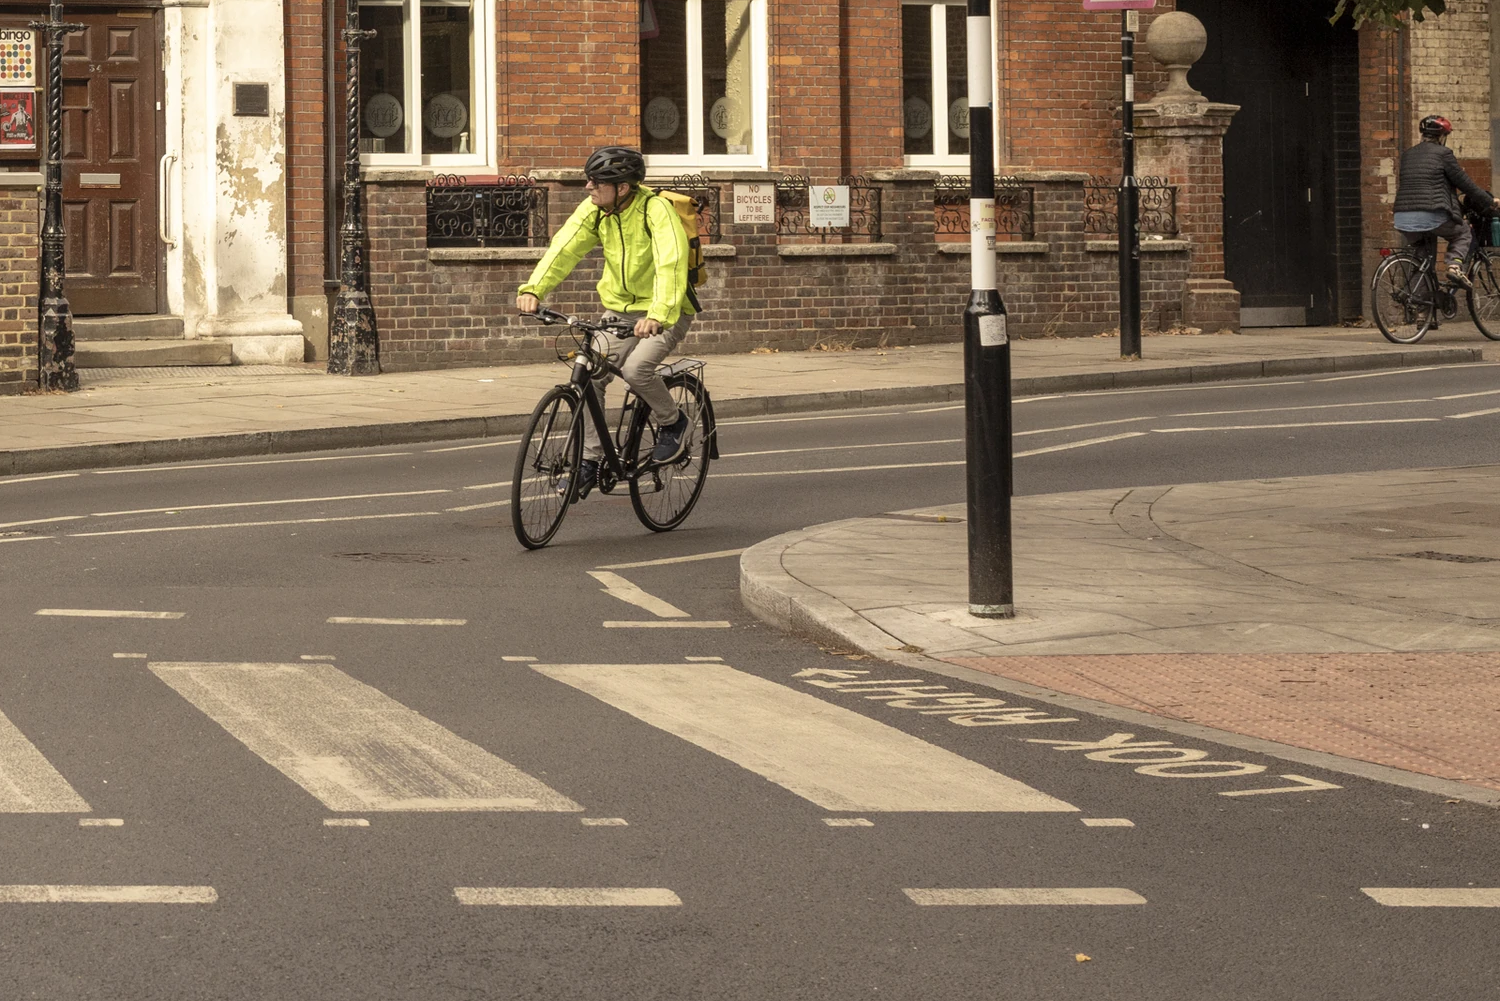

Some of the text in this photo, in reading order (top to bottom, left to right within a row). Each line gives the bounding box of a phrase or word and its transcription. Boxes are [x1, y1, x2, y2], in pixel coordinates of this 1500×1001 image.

[0, 28, 31, 42] bingo
[748, 184, 760, 193] NO
[736, 195, 772, 204] BICYCLES
[746, 205, 763, 213] TO BE
[754, 214, 770, 222] HERE
[811, 676, 1344, 798] LOOK RIGHT
